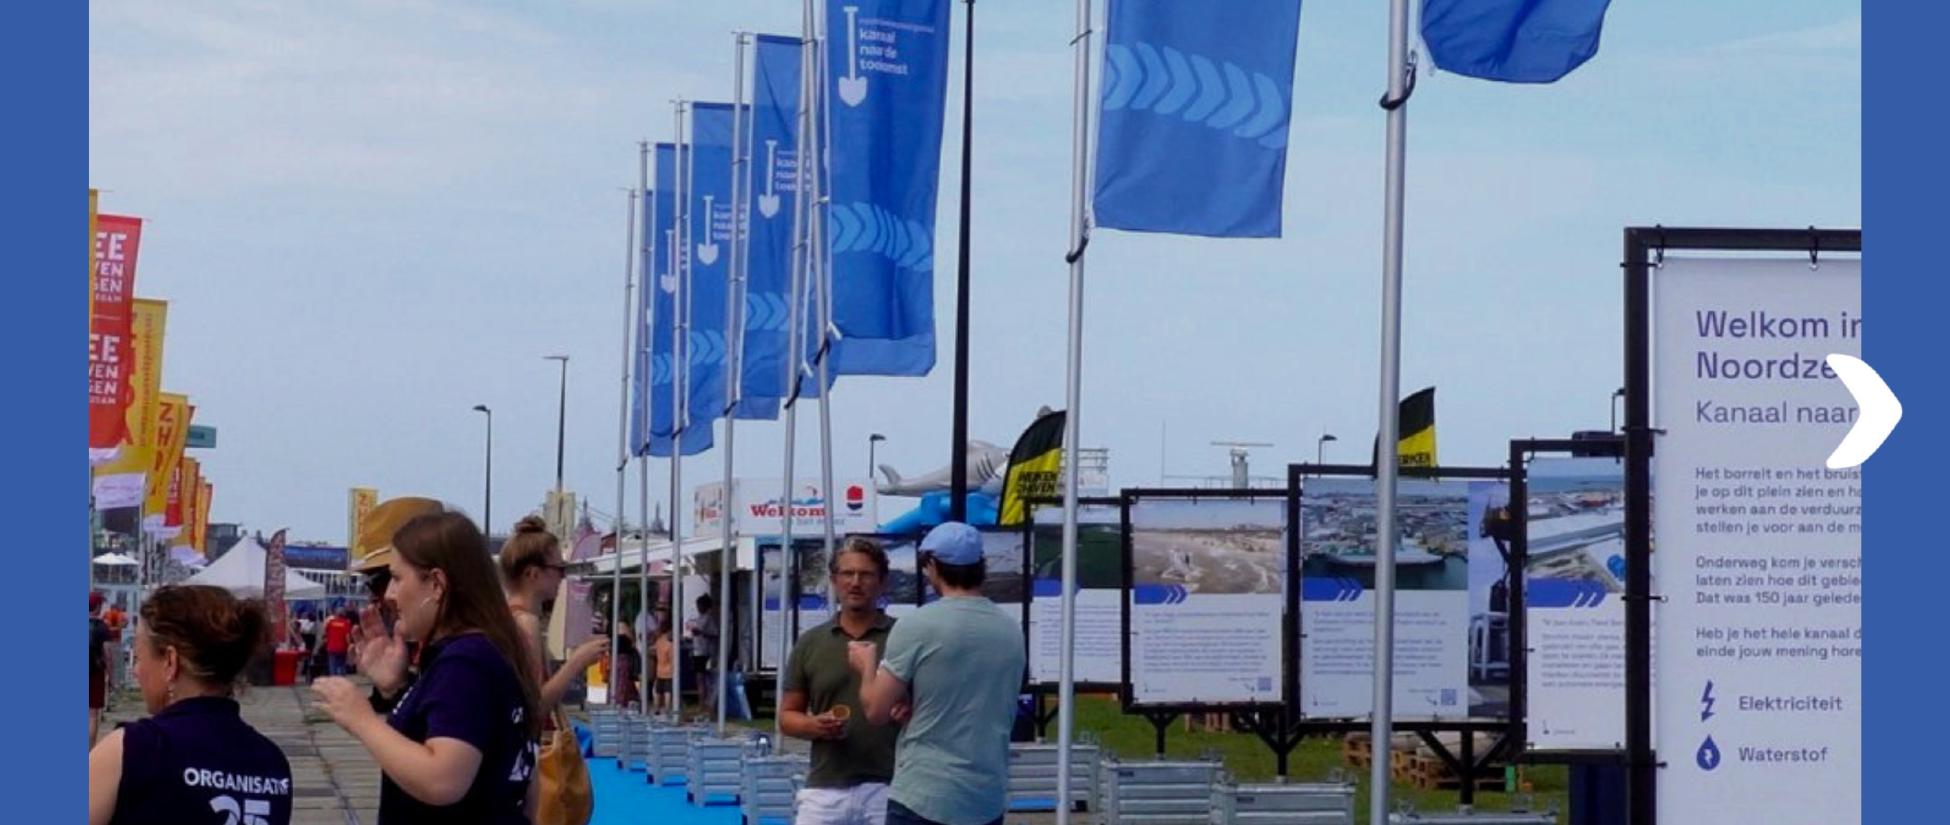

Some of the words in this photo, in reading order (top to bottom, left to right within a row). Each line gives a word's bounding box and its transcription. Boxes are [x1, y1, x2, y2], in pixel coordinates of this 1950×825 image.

[1696, 310, 1828, 338] Welkom
[1697, 400, 1787, 423] Kanaal
[1797, 406, 1858, 423] naar
[1696, 467, 1720, 480] Het
[1724, 467, 1771, 480] borrelt
[1776, 471, 1793, 480] en
[1797, 467, 1820, 480] het
[1695, 485, 1708, 500] je
[1712, 488, 1730, 499] op
[1734, 485, 1752, 498] dit
[1757, 485, 1791, 499] plein
[1795, 486, 1823, 498] zien
[1828, 488, 1844, 498] en
[1696, 503, 1746, 515] werken
[1750, 505, 1776, 515] aan
[1780, 503, 1797, 515] de
[1696, 521, 1743, 533] stellen
[1746, 521, 1759, 536] je
[1763, 523, 1794, 533] voor
[1798, 523, 1823, 533] aan
[1827, 521, 1844, 533] de
[1696, 556, 1767, 571] Onderweg
[1771, 557, 1800, 569] kom
[1802, 557, 1816, 571] je
[1696, 574, 1732, 586] laten
[1736, 574, 1764, 586] zien
[1768, 574, 1794, 586] hoe
[1798, 574, 1817, 586] dit
[1696, 591, 1720, 603] Dat
[1724, 594, 1751, 603] was
[1756, 591, 1780, 603] 150
[1782, 592, 1809, 607] jaar
[1696, 627, 1723, 639] Heb
[1727, 627, 1740, 642] je
[1744, 627, 1767, 639] het
[1771, 627, 1800, 639] hele
[1804, 627, 1850, 639] kanaal
[1696, 645, 1735, 657] einde
[1739, 645, 1772, 660] jouw
[1776, 645, 1828, 660] mening
[1739, 695, 1843, 711] Elektriciteit
[1739, 747, 1828, 762] Waterstof
